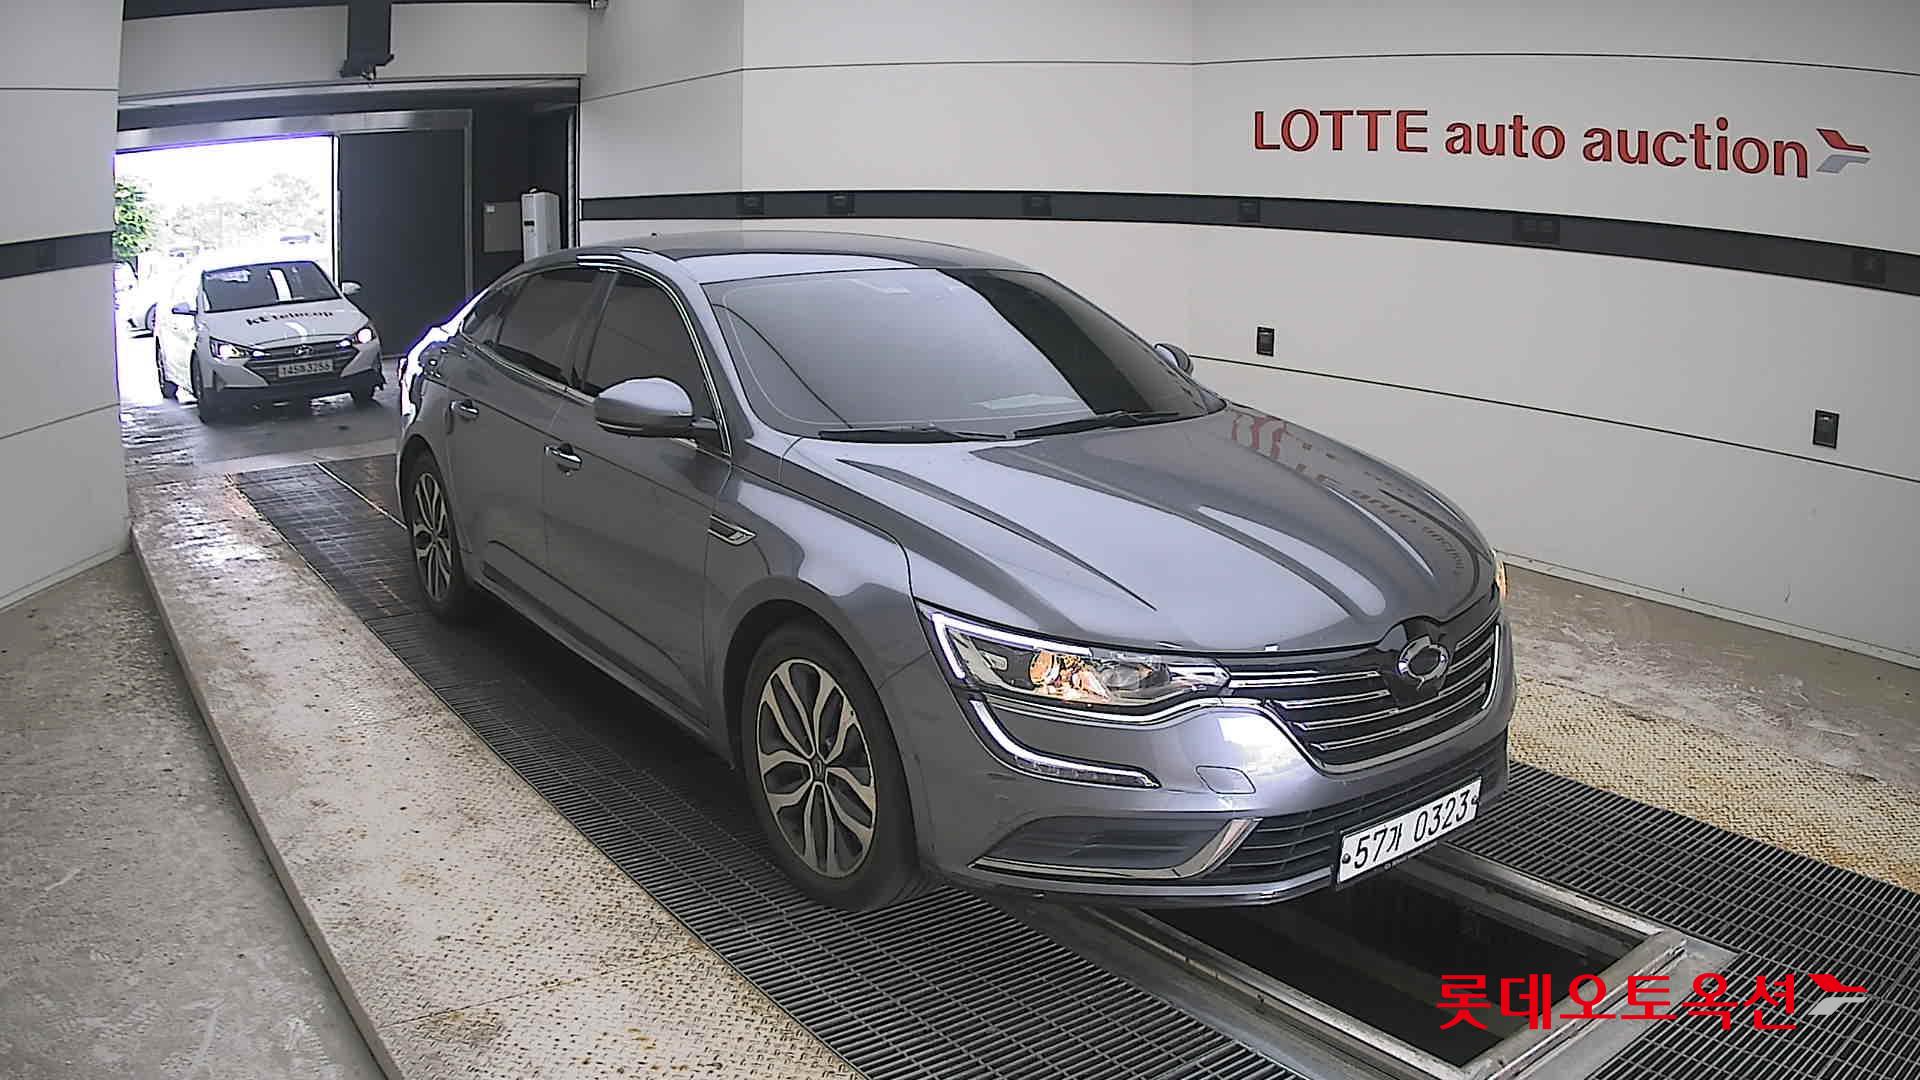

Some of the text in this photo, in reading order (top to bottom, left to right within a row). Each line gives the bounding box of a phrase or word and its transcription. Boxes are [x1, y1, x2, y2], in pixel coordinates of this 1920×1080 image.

[1254, 109, 1808, 178] LOTTE auto auction
[1353, 822, 1403, 869] 57가
[1413, 789, 1470, 843] 0323
